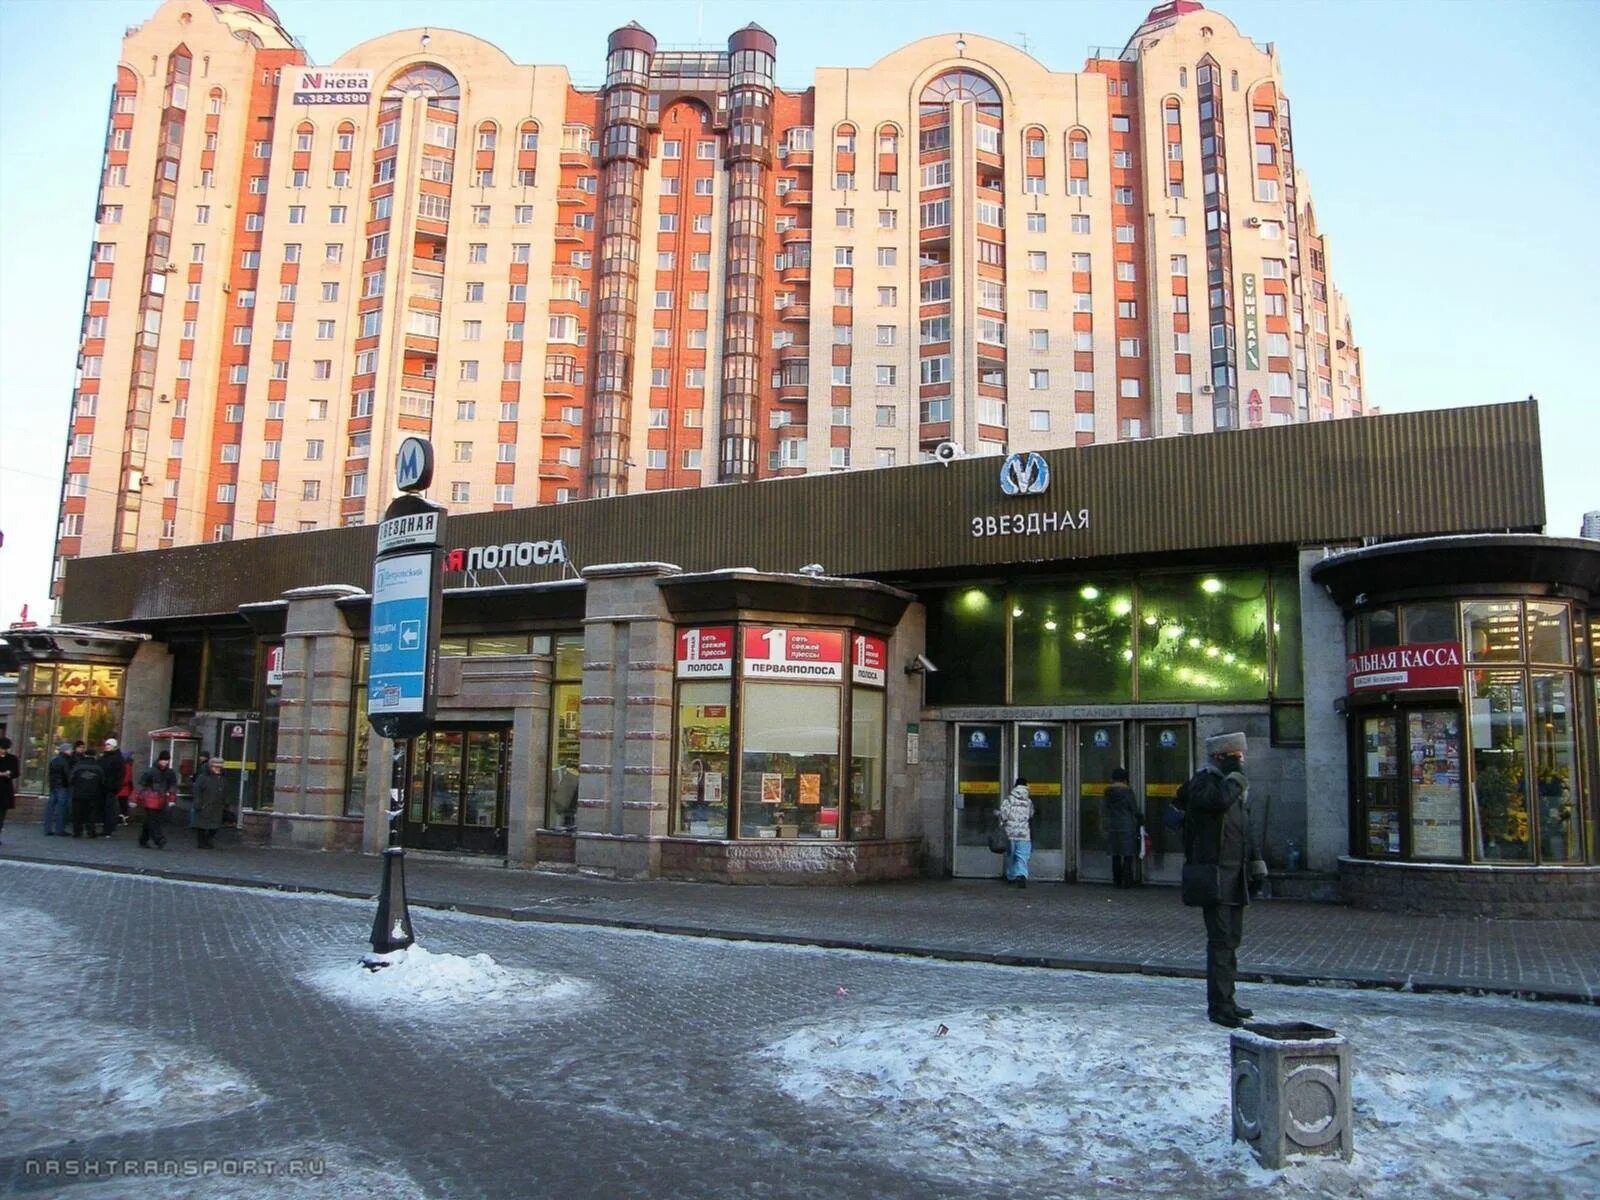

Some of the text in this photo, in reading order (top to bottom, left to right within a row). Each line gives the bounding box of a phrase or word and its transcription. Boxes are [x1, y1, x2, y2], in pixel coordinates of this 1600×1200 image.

[1244, 276, 1257, 349] СУШИ БАР
[972, 509, 1089, 537] ЗВЕЗДНАЯ
[688, 664, 724, 672] ПОЛОСА
[1401, 648, 1459, 667] КАССА
